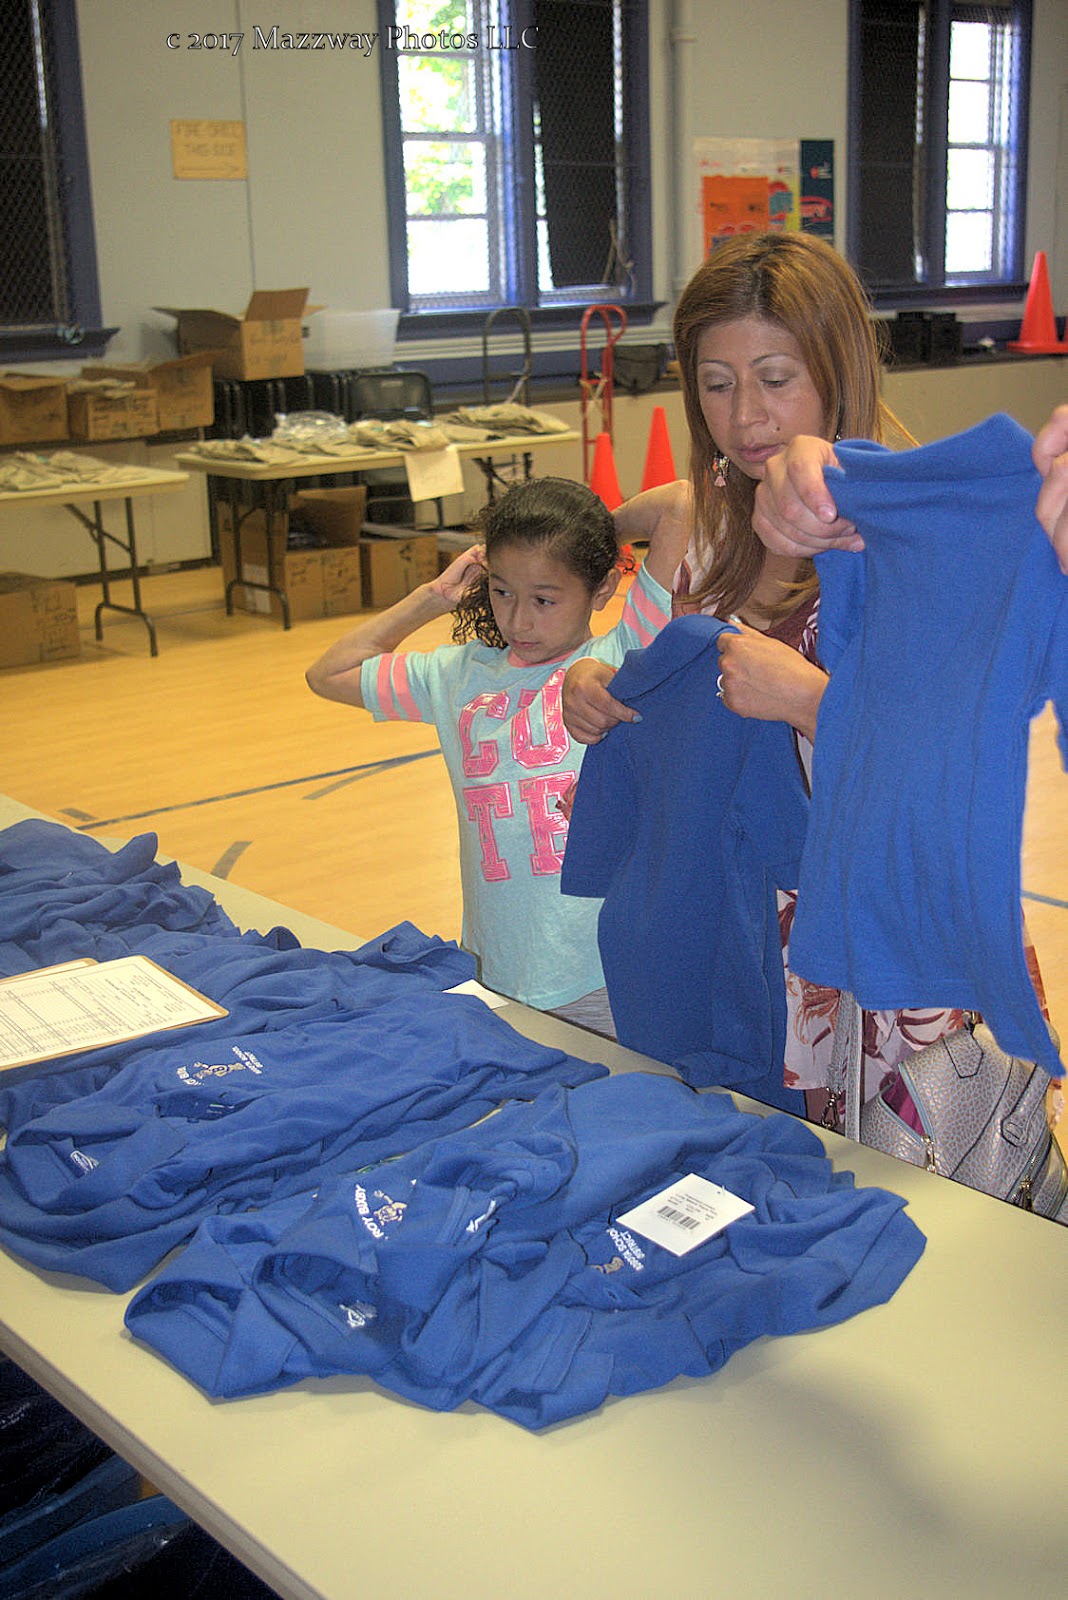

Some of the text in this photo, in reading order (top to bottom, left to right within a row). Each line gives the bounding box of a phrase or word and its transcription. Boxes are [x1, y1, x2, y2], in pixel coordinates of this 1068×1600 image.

[459, 668, 570, 777] CU
[462, 770, 577, 882] TE
[362, 1216, 385, 1238] ROY
